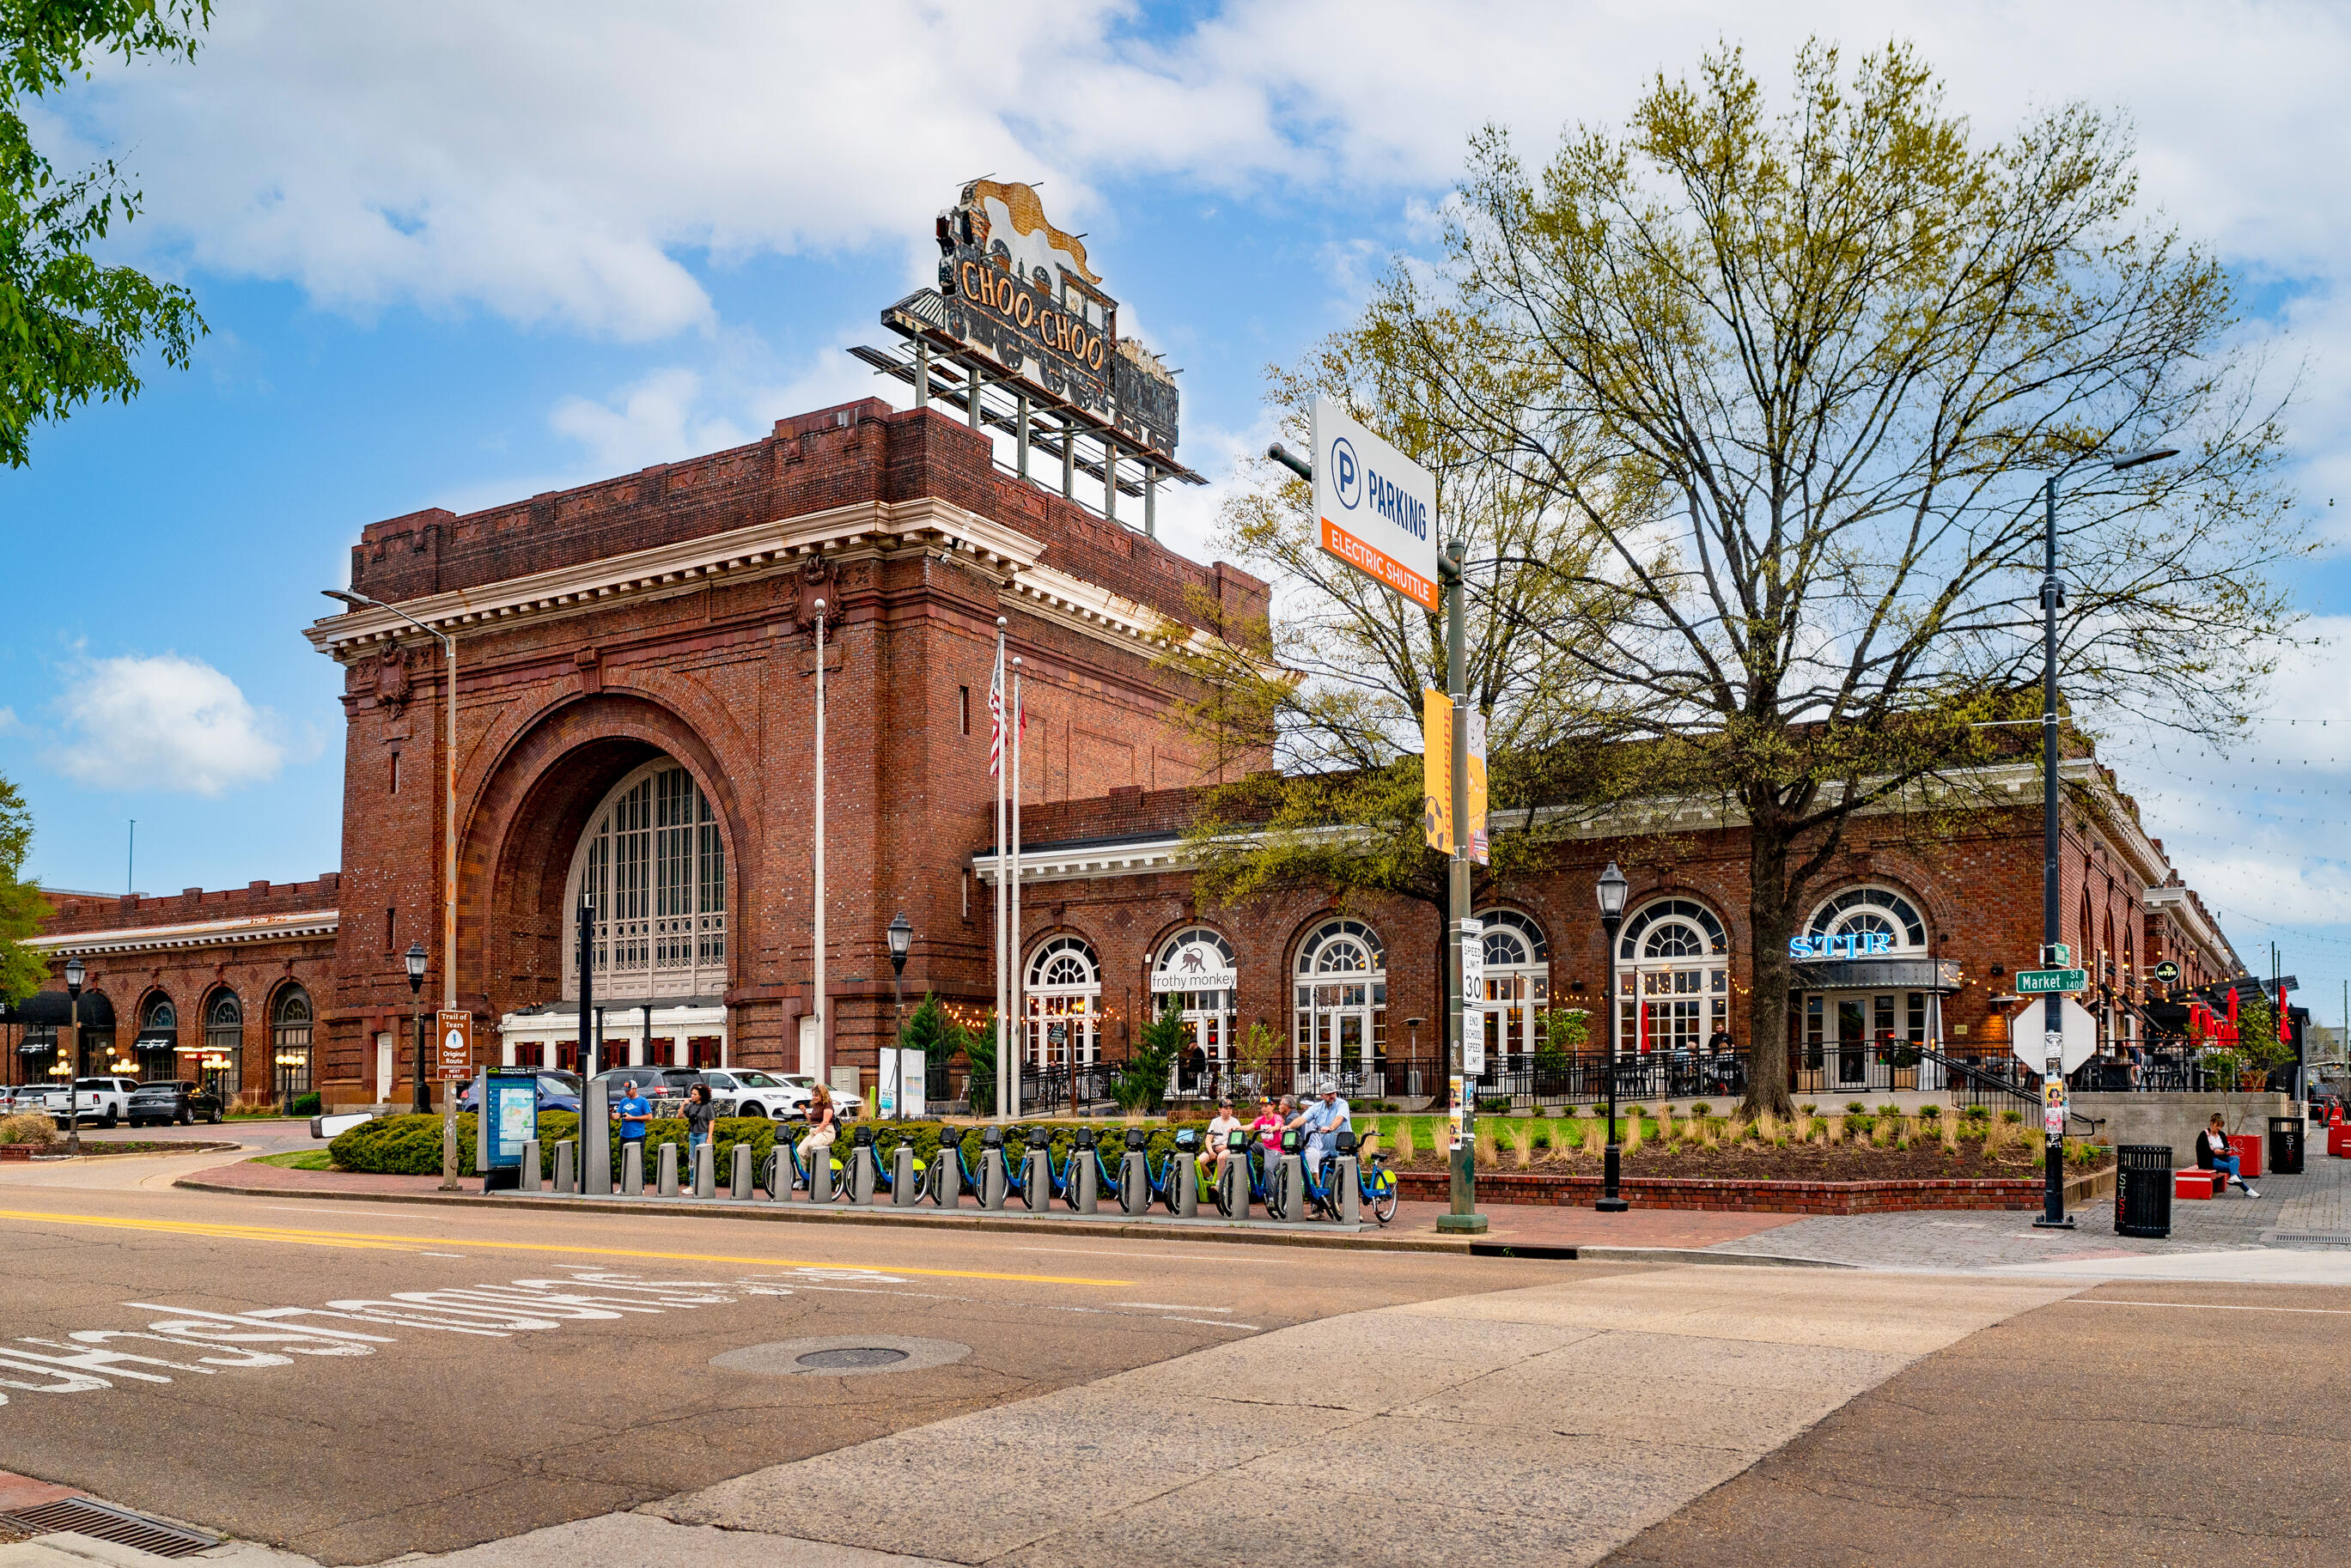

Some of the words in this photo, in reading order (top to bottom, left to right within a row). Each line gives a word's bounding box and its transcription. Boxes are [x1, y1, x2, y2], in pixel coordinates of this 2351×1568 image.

[1367, 468, 1427, 542] PARKING
[1331, 529, 1385, 576] ELECTRIC
[1386, 561, 1430, 602] SHUTTLE
[1443, 708, 1453, 846] SOUTHSIDE
[1464, 945, 1482, 957] SPEED
[1789, 933, 1892, 959] STIR
[1465, 959, 1480, 970] LIMIT
[1153, 974, 1187, 989] frothy
[1190, 972, 1236, 988] monkey
[1465, 975, 1482, 998] 30
[2022, 974, 2061, 990] Market
[2069, 970, 2079, 979] St
[2066, 980, 2085, 990] 1400
[1469, 1016, 1478, 1026] END
[1465, 1029, 1483, 1040] SCHOOL
[1467, 1042, 1482, 1053] SPEED
[1468, 1056, 1480, 1066] LIMIT
